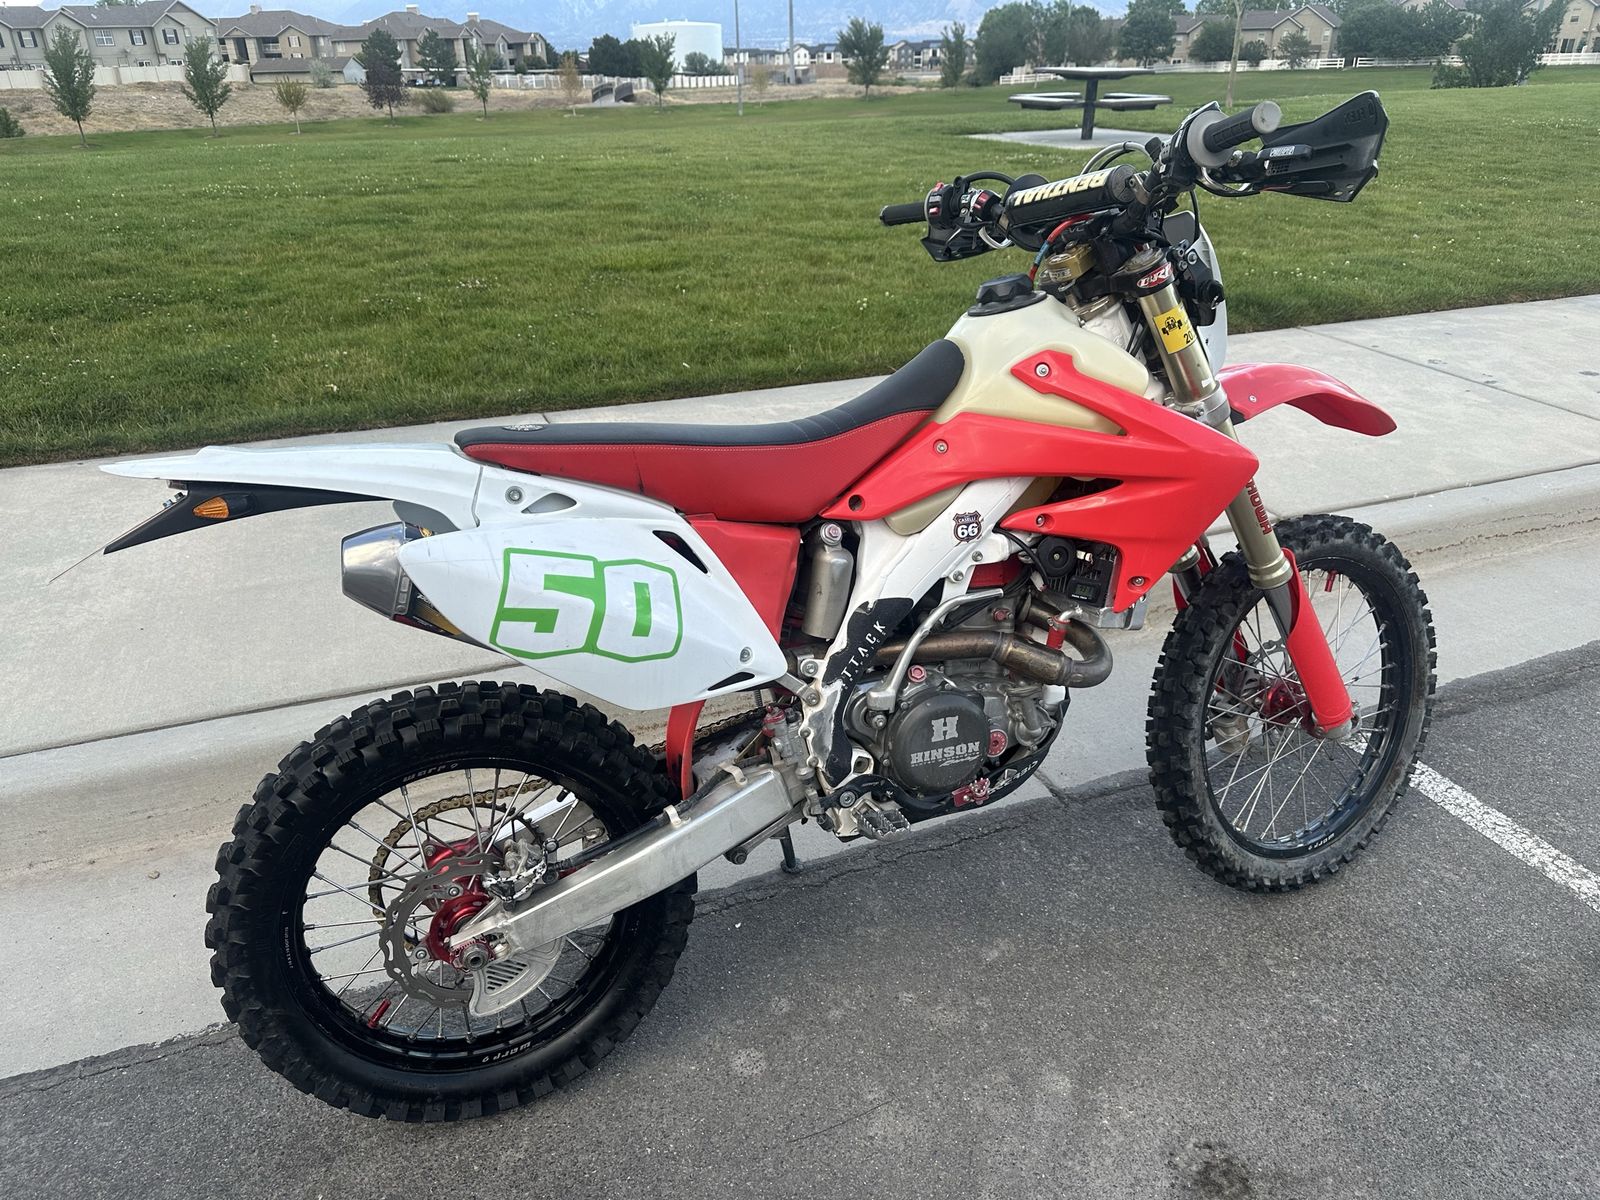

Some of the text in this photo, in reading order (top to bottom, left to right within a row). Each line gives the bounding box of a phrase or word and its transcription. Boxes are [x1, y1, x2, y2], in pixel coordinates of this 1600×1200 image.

[1013, 168, 1111, 207] RENTHAL
[1246, 480, 1272, 535] HOWA
[957, 523, 979, 538] 66
[489, 547, 683, 663] 50
[841, 620, 886, 684] TTACK
[931, 715, 959, 742] H
[910, 741, 980, 764] HINSON
